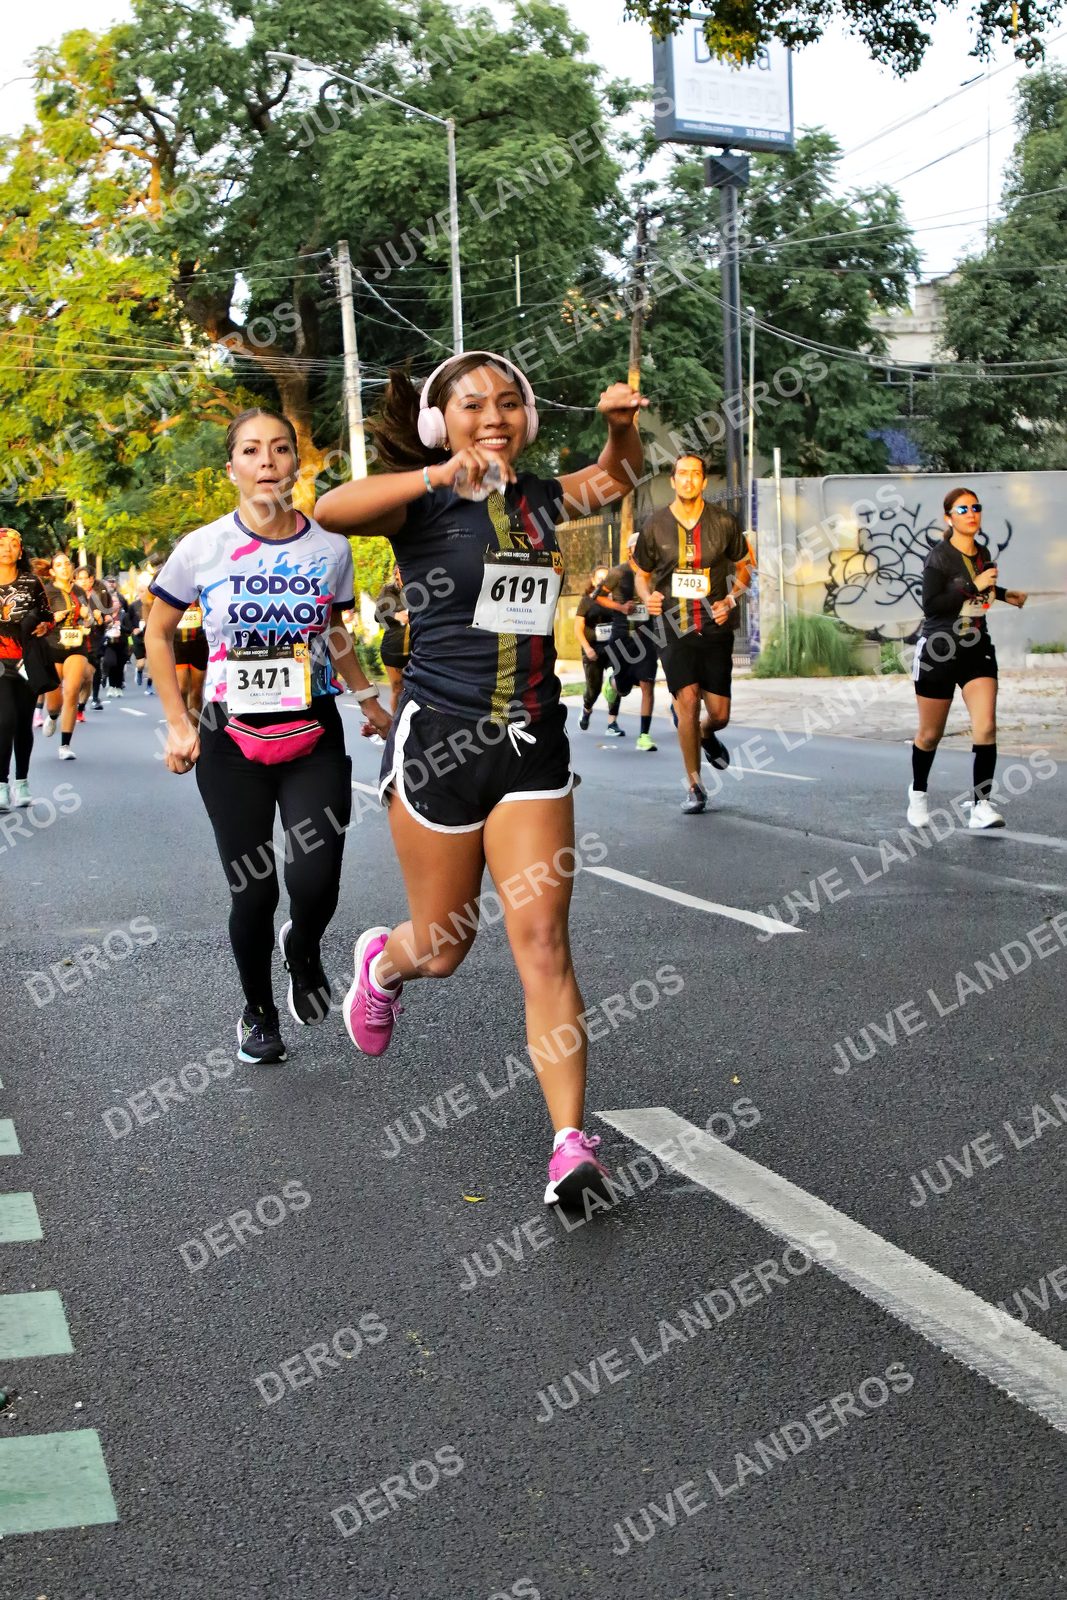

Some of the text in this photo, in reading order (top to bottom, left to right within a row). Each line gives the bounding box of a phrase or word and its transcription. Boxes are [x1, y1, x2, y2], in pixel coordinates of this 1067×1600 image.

[858, 503, 922, 528] TOY
[229, 575, 322, 596] TODOS
[490, 576, 549, 605] 6191
[677, 577, 702, 588] 7403
[227, 601, 326, 625] SOMOS
[237, 667, 290, 690] 3471
